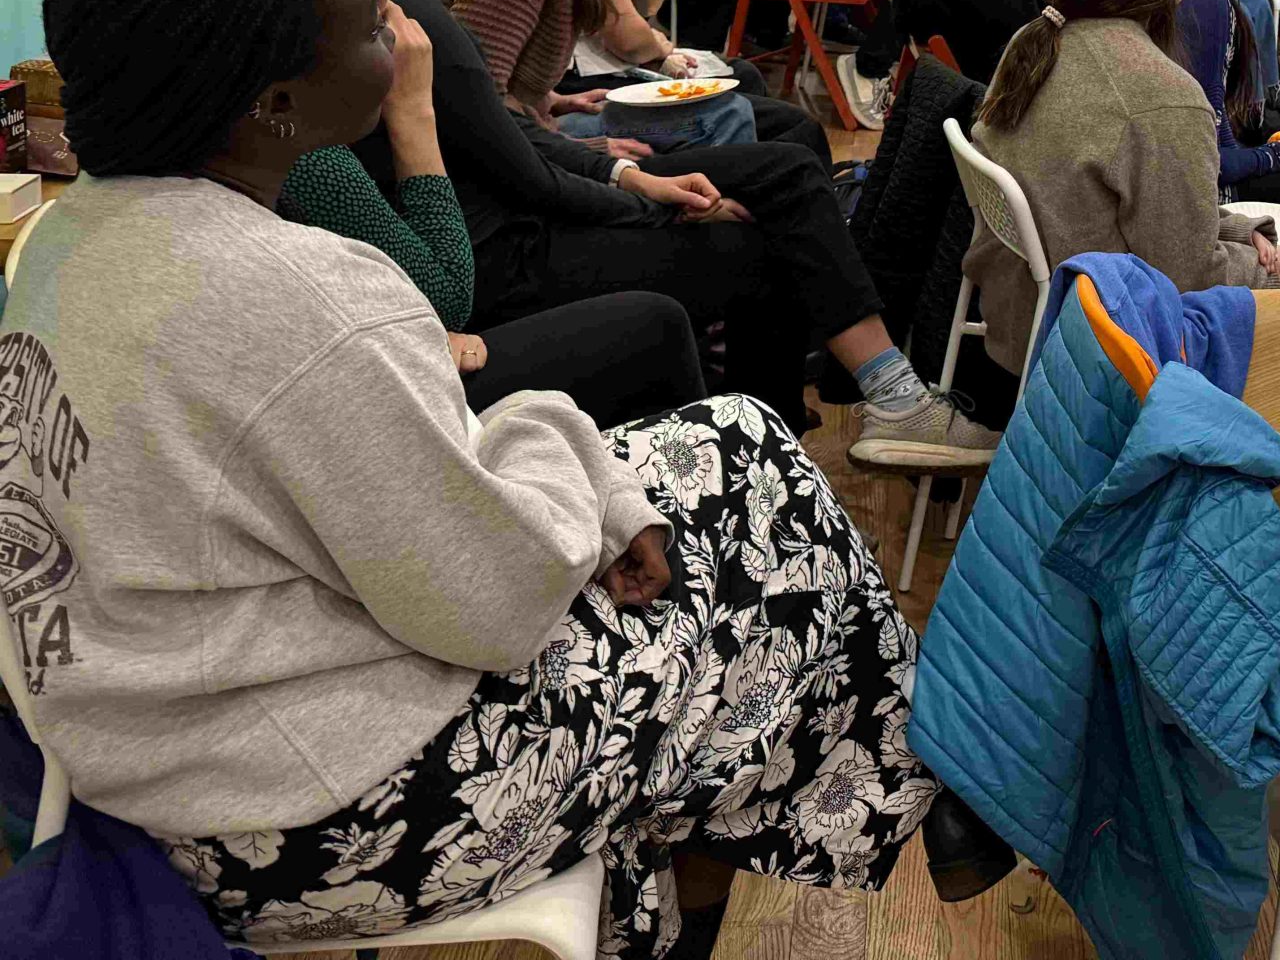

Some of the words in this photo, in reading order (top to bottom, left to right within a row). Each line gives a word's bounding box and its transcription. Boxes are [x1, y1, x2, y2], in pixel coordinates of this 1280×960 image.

[0, 108, 25, 128] white
[11, 122, 26, 137] tea
[0, 332, 58, 424] RSITY
[49, 393, 90, 501] OF
